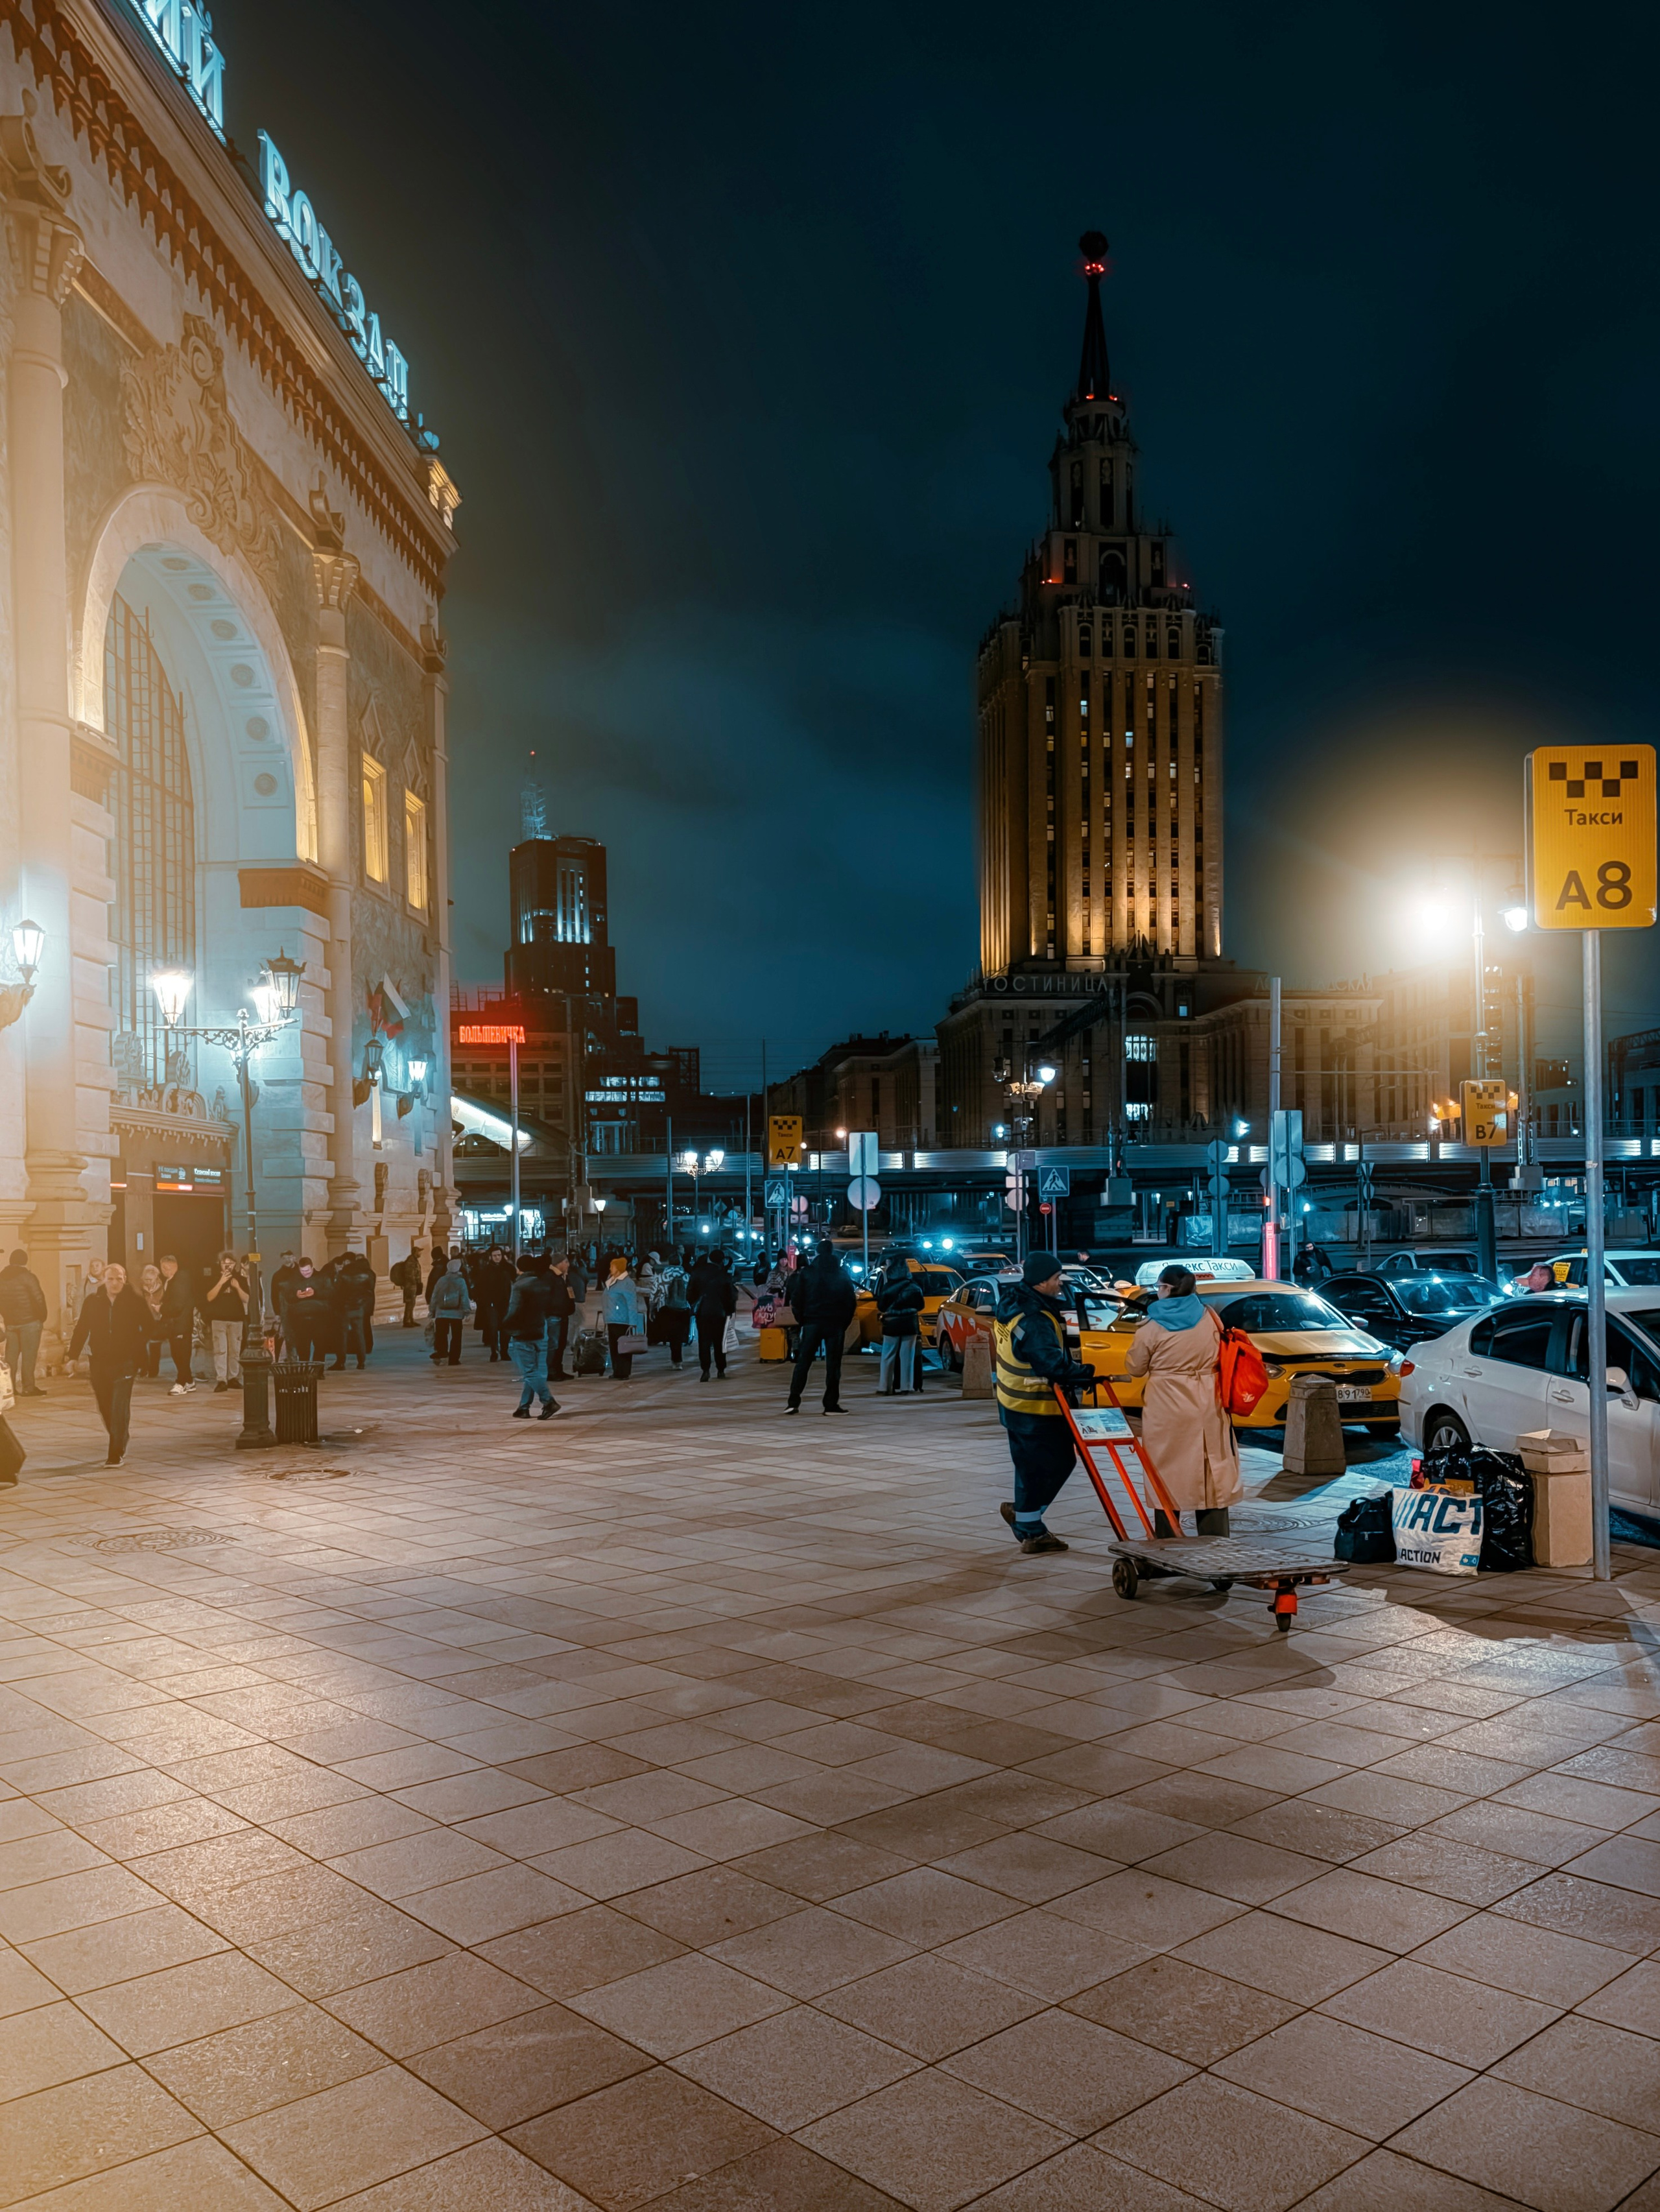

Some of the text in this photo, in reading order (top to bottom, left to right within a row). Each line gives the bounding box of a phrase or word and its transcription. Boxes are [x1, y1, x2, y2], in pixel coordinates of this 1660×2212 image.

[257, 128, 409, 407] ВОКЗАЛ
[1564, 809, 1622, 826] Такси
[1556, 861, 1632, 910] A8
[983, 976, 1108, 992] ГОСТИНИЦА
[459, 1025, 525, 1043] БОЛЬШЕВИЧКА
[1476, 1122, 1499, 1139] B7
[776, 1147, 794, 1160] A7
[1206, 1260, 1239, 1271] Такси
[1401, 1549, 1441, 1564] ACTION
